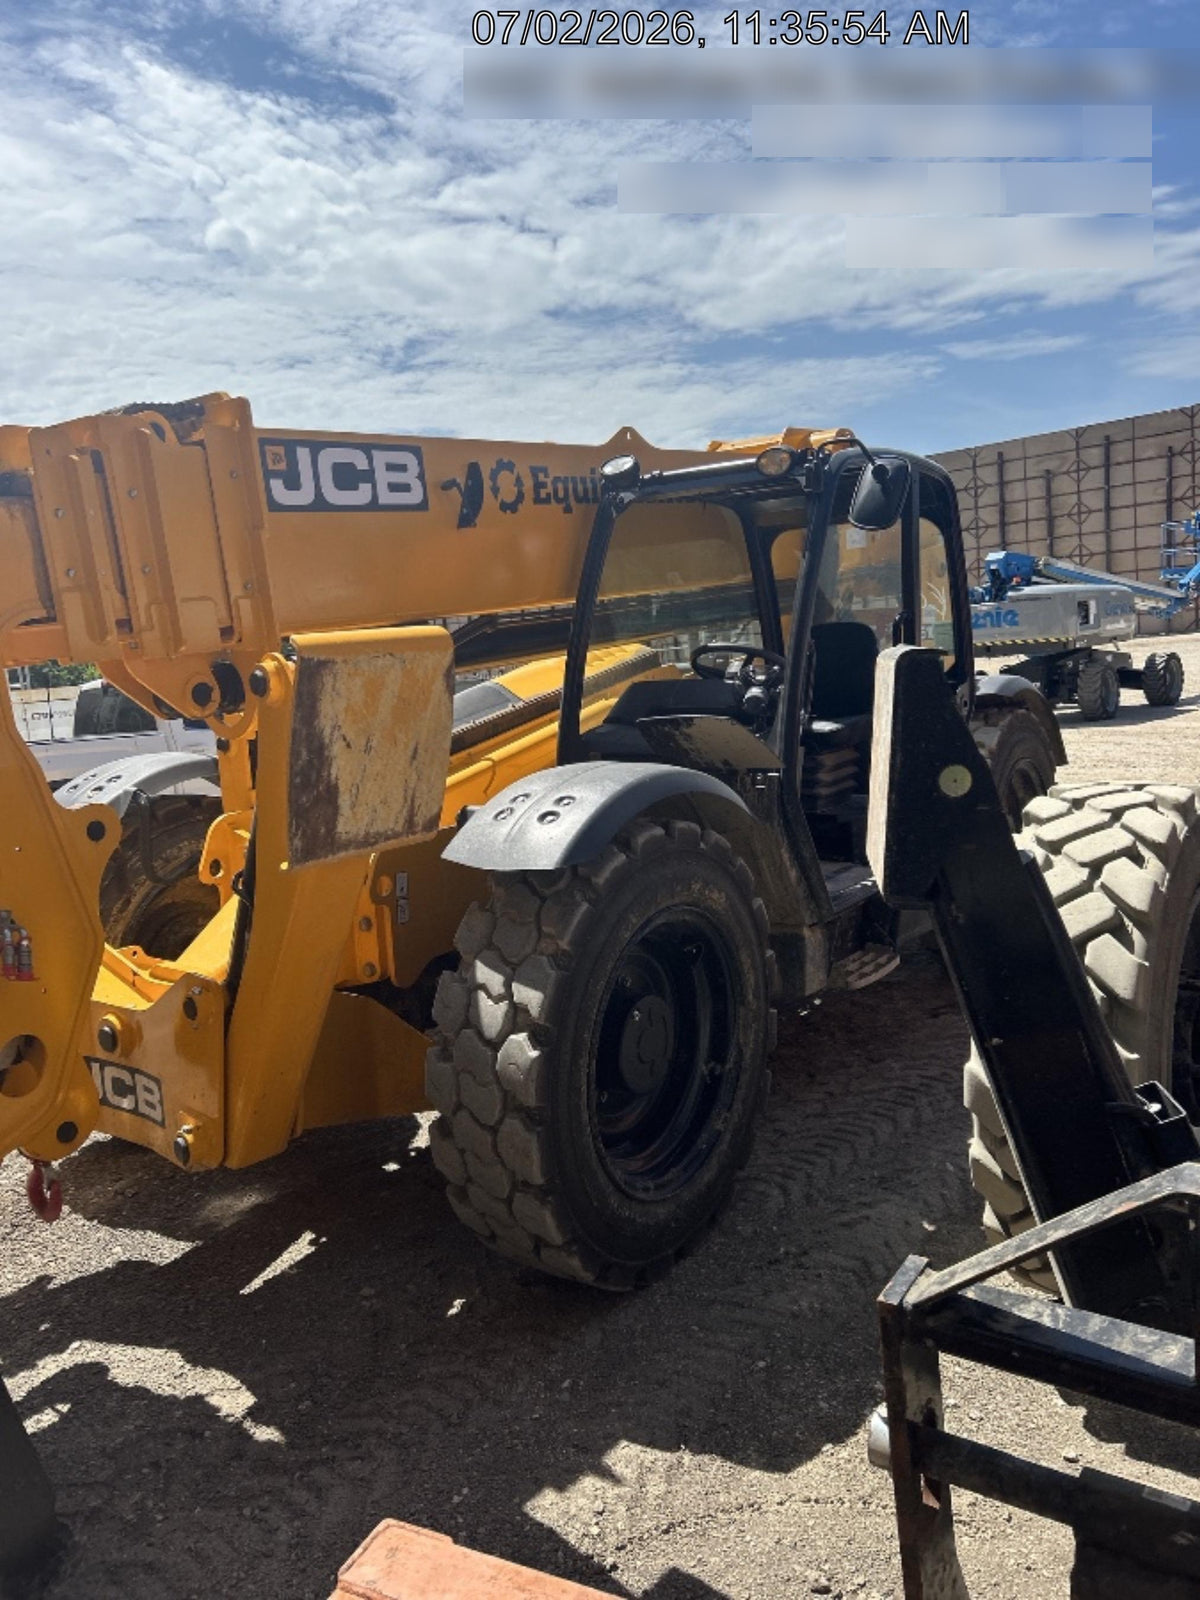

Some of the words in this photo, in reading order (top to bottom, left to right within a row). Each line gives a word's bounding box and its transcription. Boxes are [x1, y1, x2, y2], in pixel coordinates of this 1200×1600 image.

[269, 447, 424, 505] JCB
[529, 465, 600, 513] Equi
[972, 606, 1019, 629] enie
